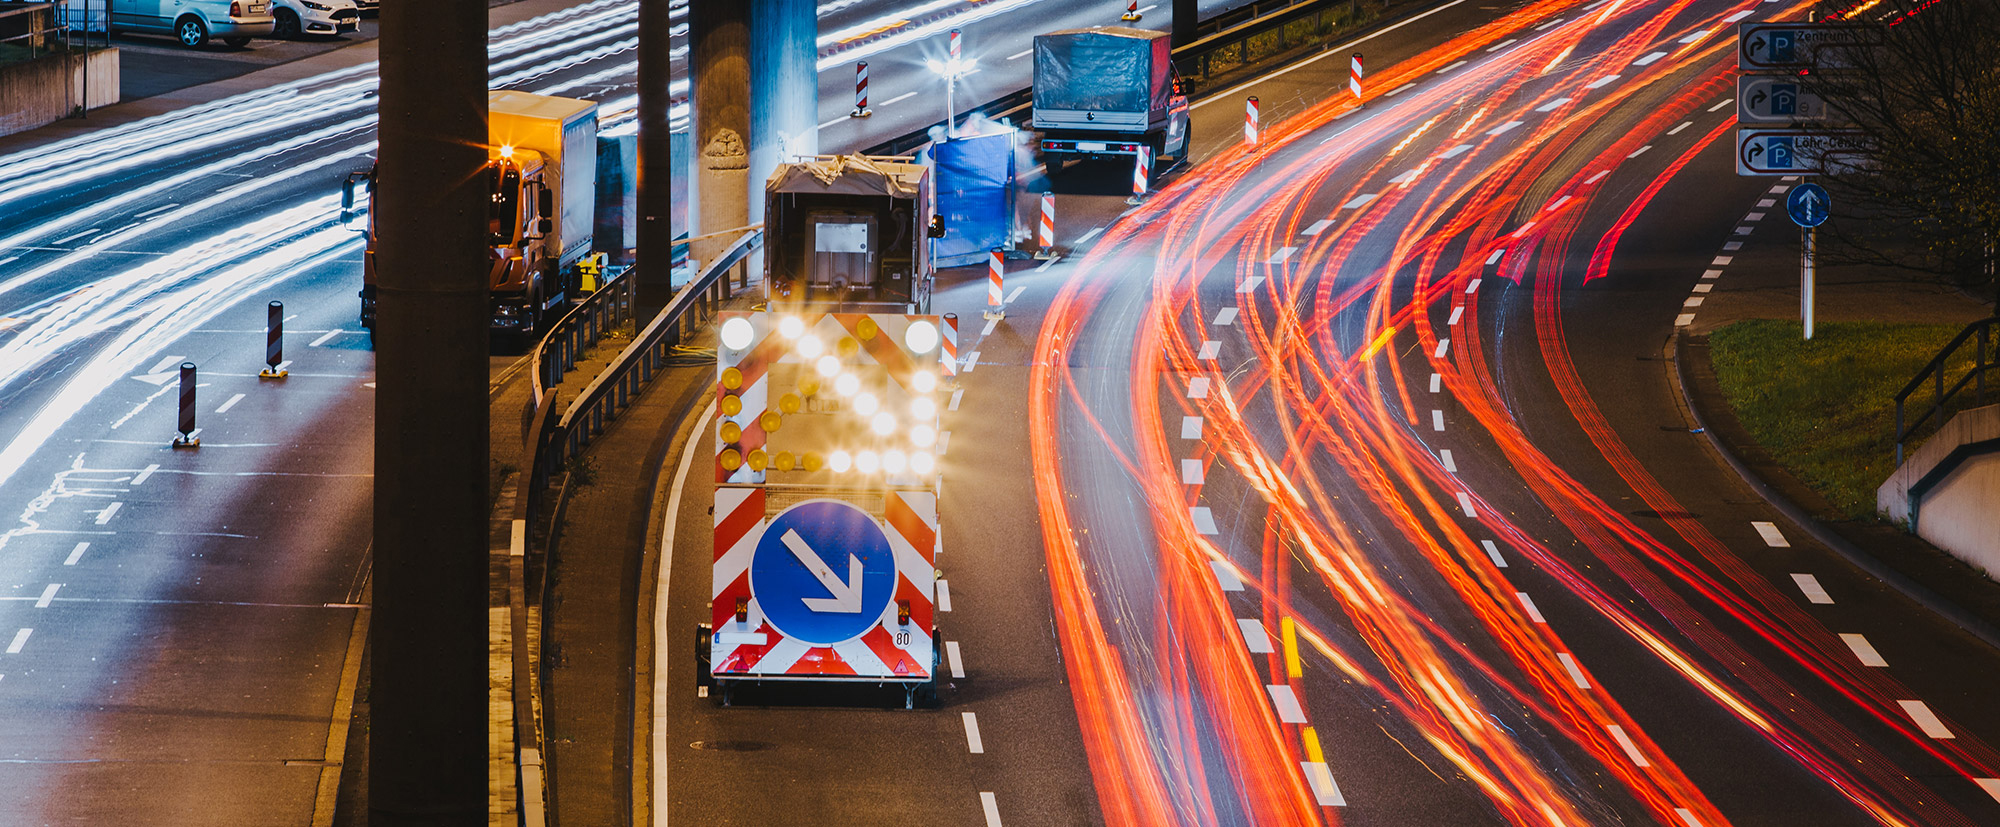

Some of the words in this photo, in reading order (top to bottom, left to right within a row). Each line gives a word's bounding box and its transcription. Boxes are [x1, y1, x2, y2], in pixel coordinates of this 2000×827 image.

[1797, 30, 1849, 42] Zentrum
[1775, 37, 1789, 55] P
[896, 632, 910, 646] 80
